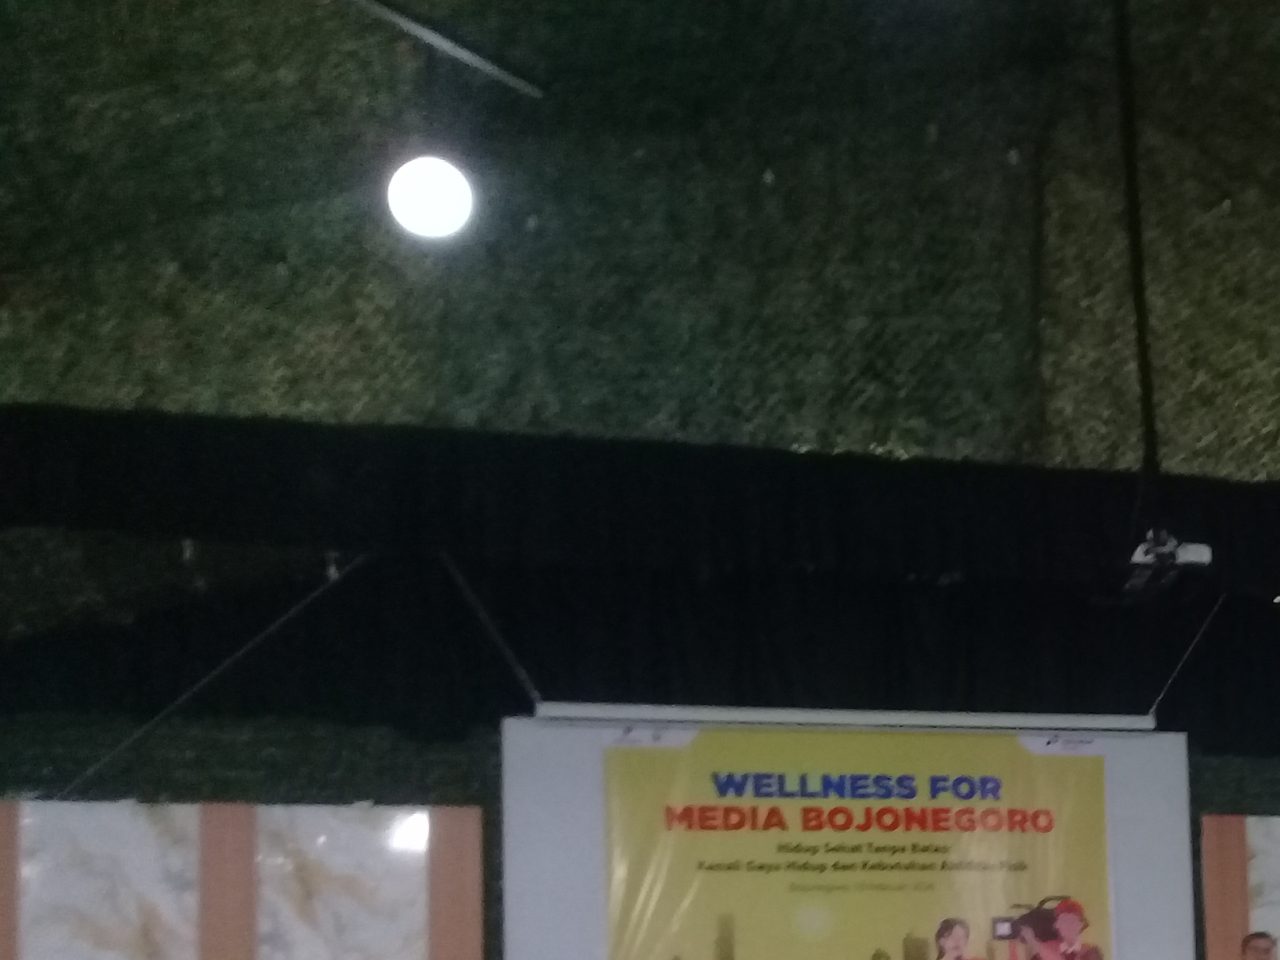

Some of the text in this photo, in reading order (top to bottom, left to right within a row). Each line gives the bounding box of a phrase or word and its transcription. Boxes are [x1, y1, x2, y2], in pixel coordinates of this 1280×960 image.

[712, 772, 1003, 800] WELLNESS FOR
[664, 805, 1055, 833] MEDIA BOJONEGORO
